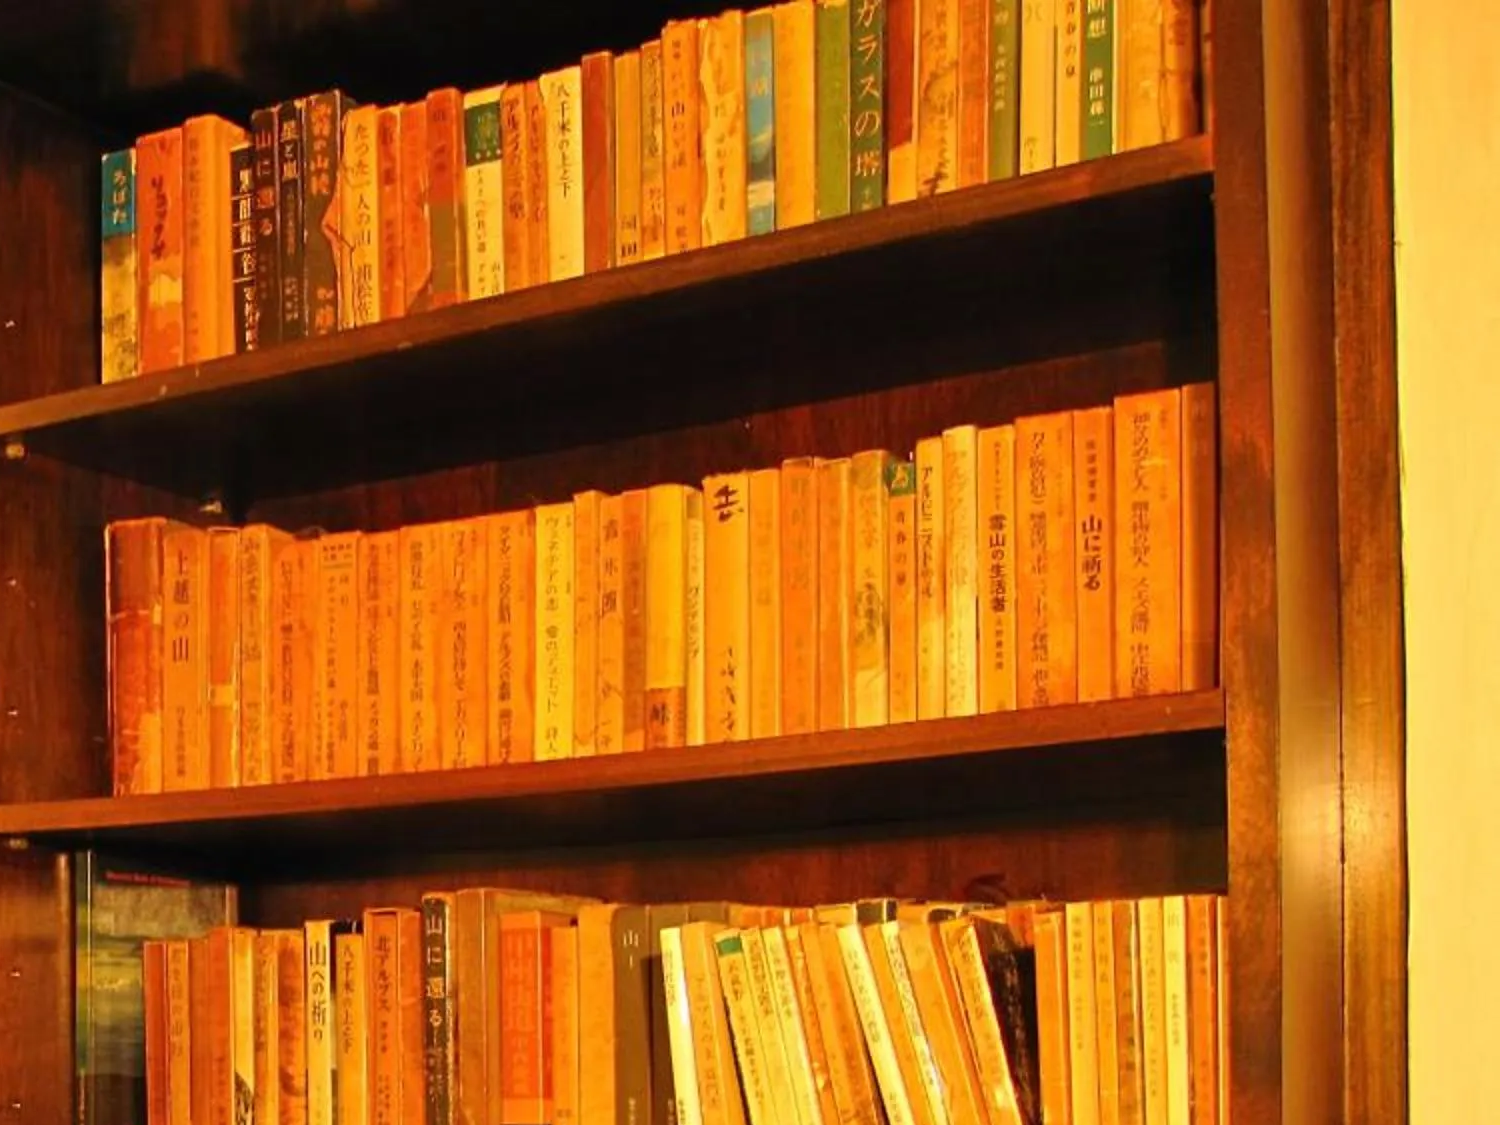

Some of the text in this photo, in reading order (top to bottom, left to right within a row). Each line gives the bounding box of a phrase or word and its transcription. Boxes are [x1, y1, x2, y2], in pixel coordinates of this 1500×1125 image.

[309, 942, 328, 1041] 山への祈り
